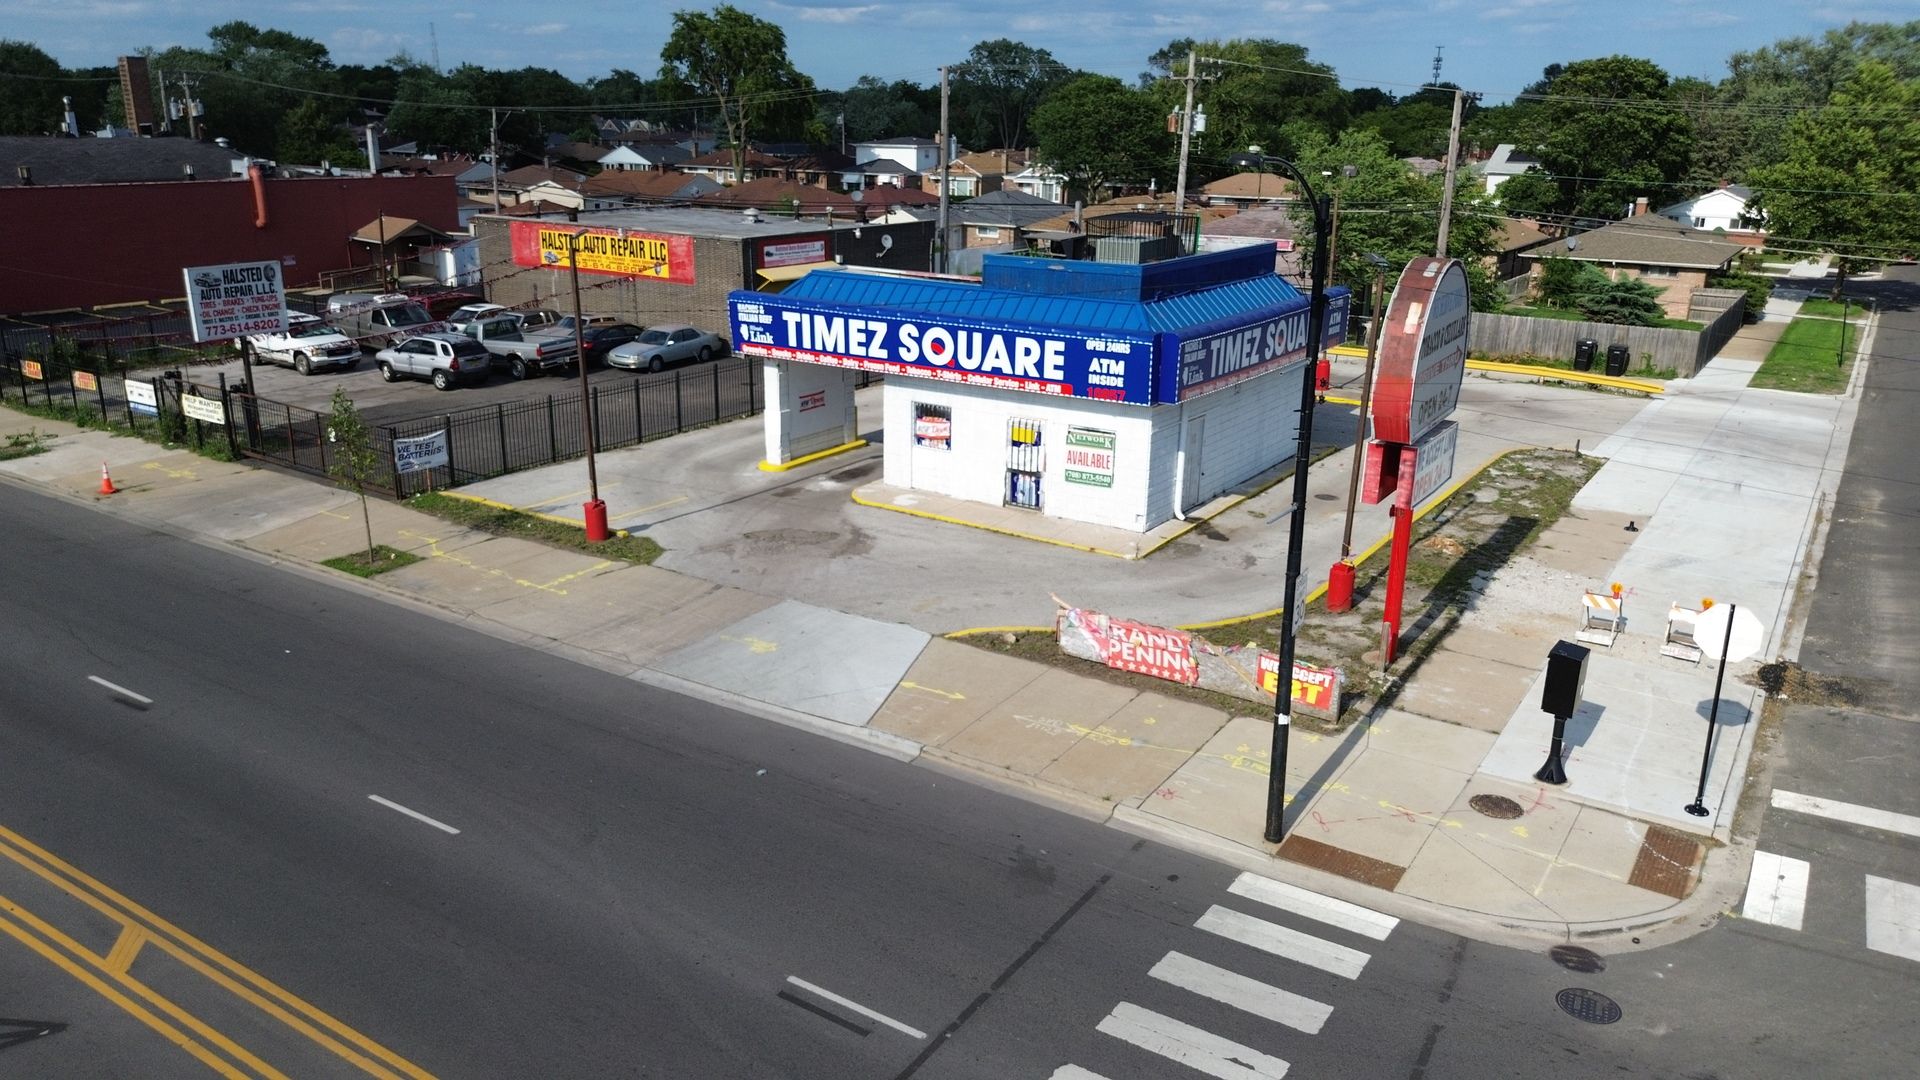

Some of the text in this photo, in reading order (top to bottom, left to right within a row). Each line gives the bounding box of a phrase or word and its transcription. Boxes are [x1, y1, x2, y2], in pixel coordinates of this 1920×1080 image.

[541, 232, 582, 252] HALSTD
[583, 235, 608, 254] AUTO
[610, 238, 646, 259] REPAIR
[650, 242, 666, 262] LLC
[222, 266, 262, 286] HALSTED
[200, 288, 222, 300] AUTO
[224, 284, 254, 298] REPAIR
[222, 298, 244, 306] BRAKES
[250, 294, 278, 304] TUNE-UPS
[213, 308, 234, 317] CHANGE
[242, 305, 260, 313] CHECK
[261, 302, 282, 312] ENGINE
[205, 318, 280, 336] 773-614-8202
[1329, 312, 1342, 326] ATM
[750, 330, 774, 344] Link
[782, 310, 1066, 380] TIMEZ SQUARE
[1210, 327, 1262, 378] TIMEZ
[1264, 311, 1311, 360] SQUA
[1086, 340, 1131, 354] OPEN 24HRS
[1088, 357, 1125, 376] ATM
[1088, 373, 1124, 388] INSIDE
[1188, 370, 1204, 385] Link
[198, 400, 222, 410] WANTED
[398, 441, 436, 453] WE TEST
[398, 446, 444, 462] BATTERIES!
[1066, 450, 1110, 470] AVAILABLE
[1110, 626, 1184, 653] RAND
[1110, 640, 1191, 670] PENIN
[1292, 666, 1333, 688] CCEPT
[1263, 672, 1324, 704] EBT
